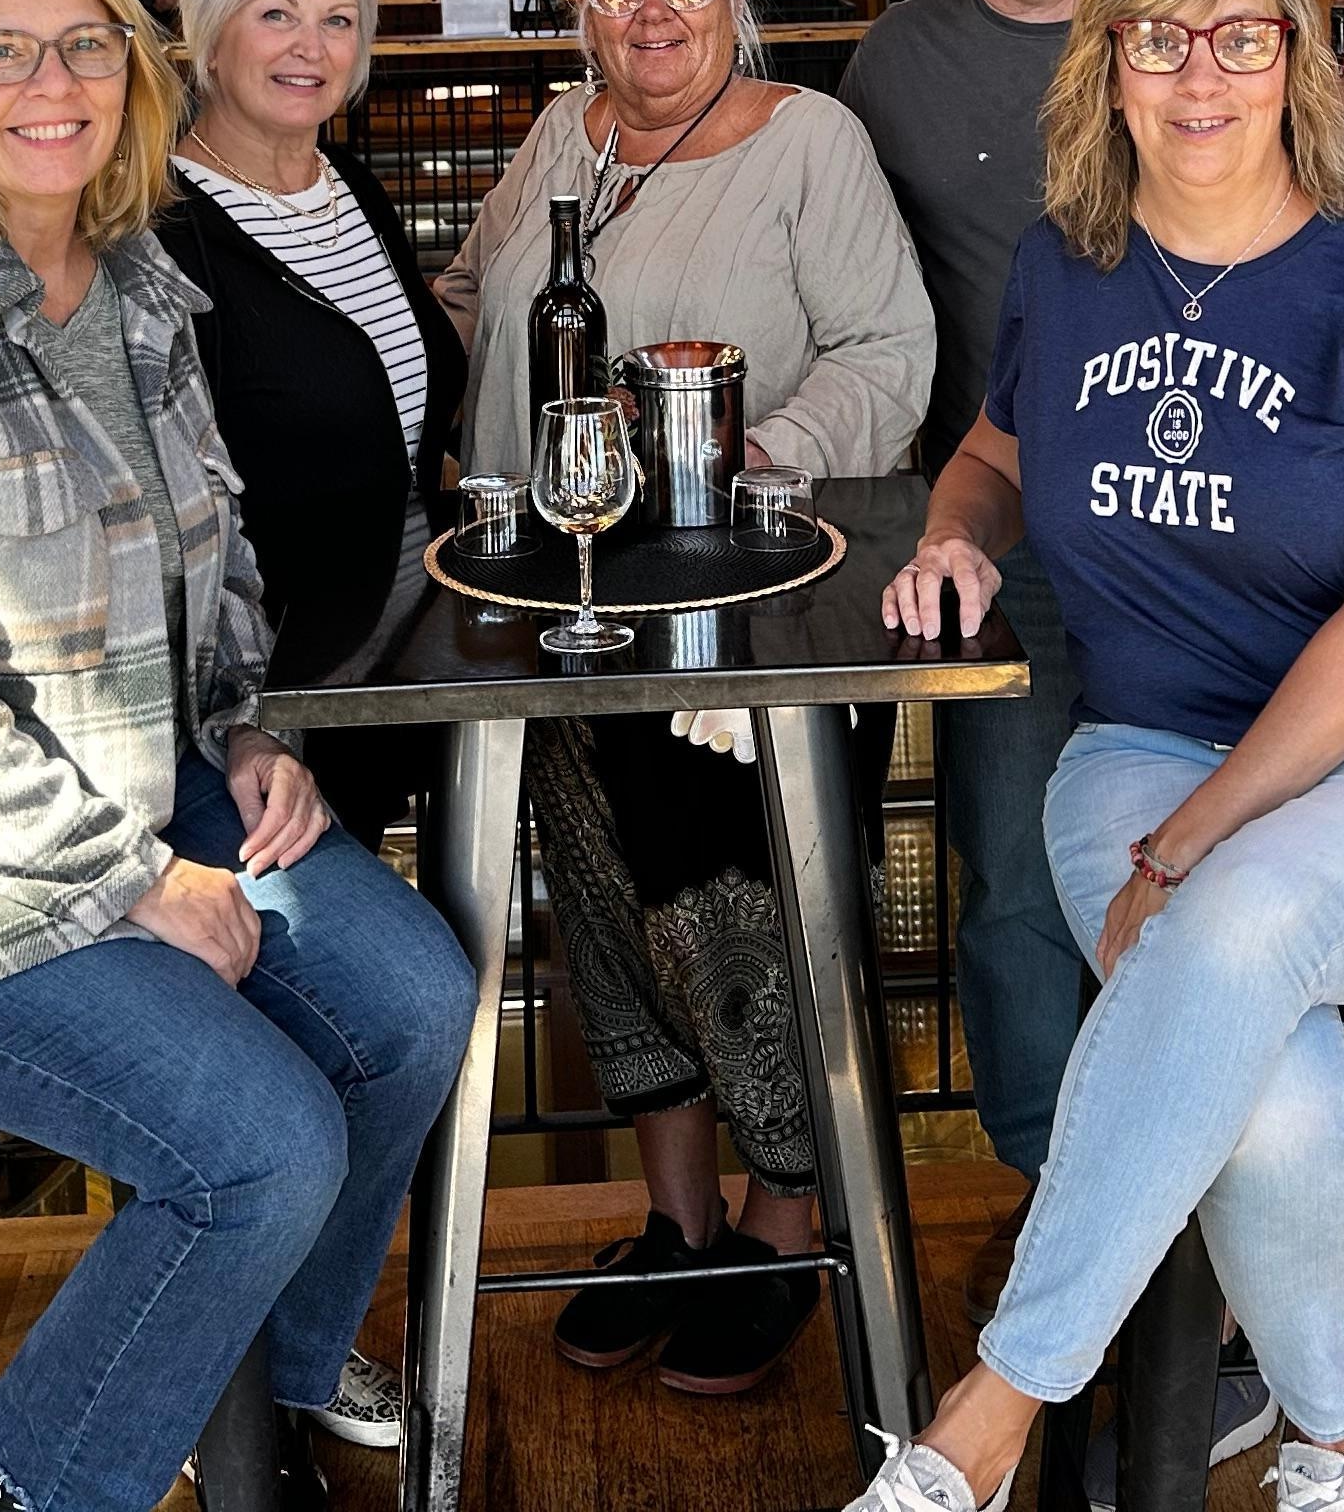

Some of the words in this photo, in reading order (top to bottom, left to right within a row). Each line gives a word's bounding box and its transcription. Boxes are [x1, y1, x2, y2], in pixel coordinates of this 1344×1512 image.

[1075, 332, 1296, 434] POSITIVE
[1163, 430, 1190, 441] GOOD
[1172, 419, 1182, 430] IS
[1090, 462, 1235, 534] STATE
